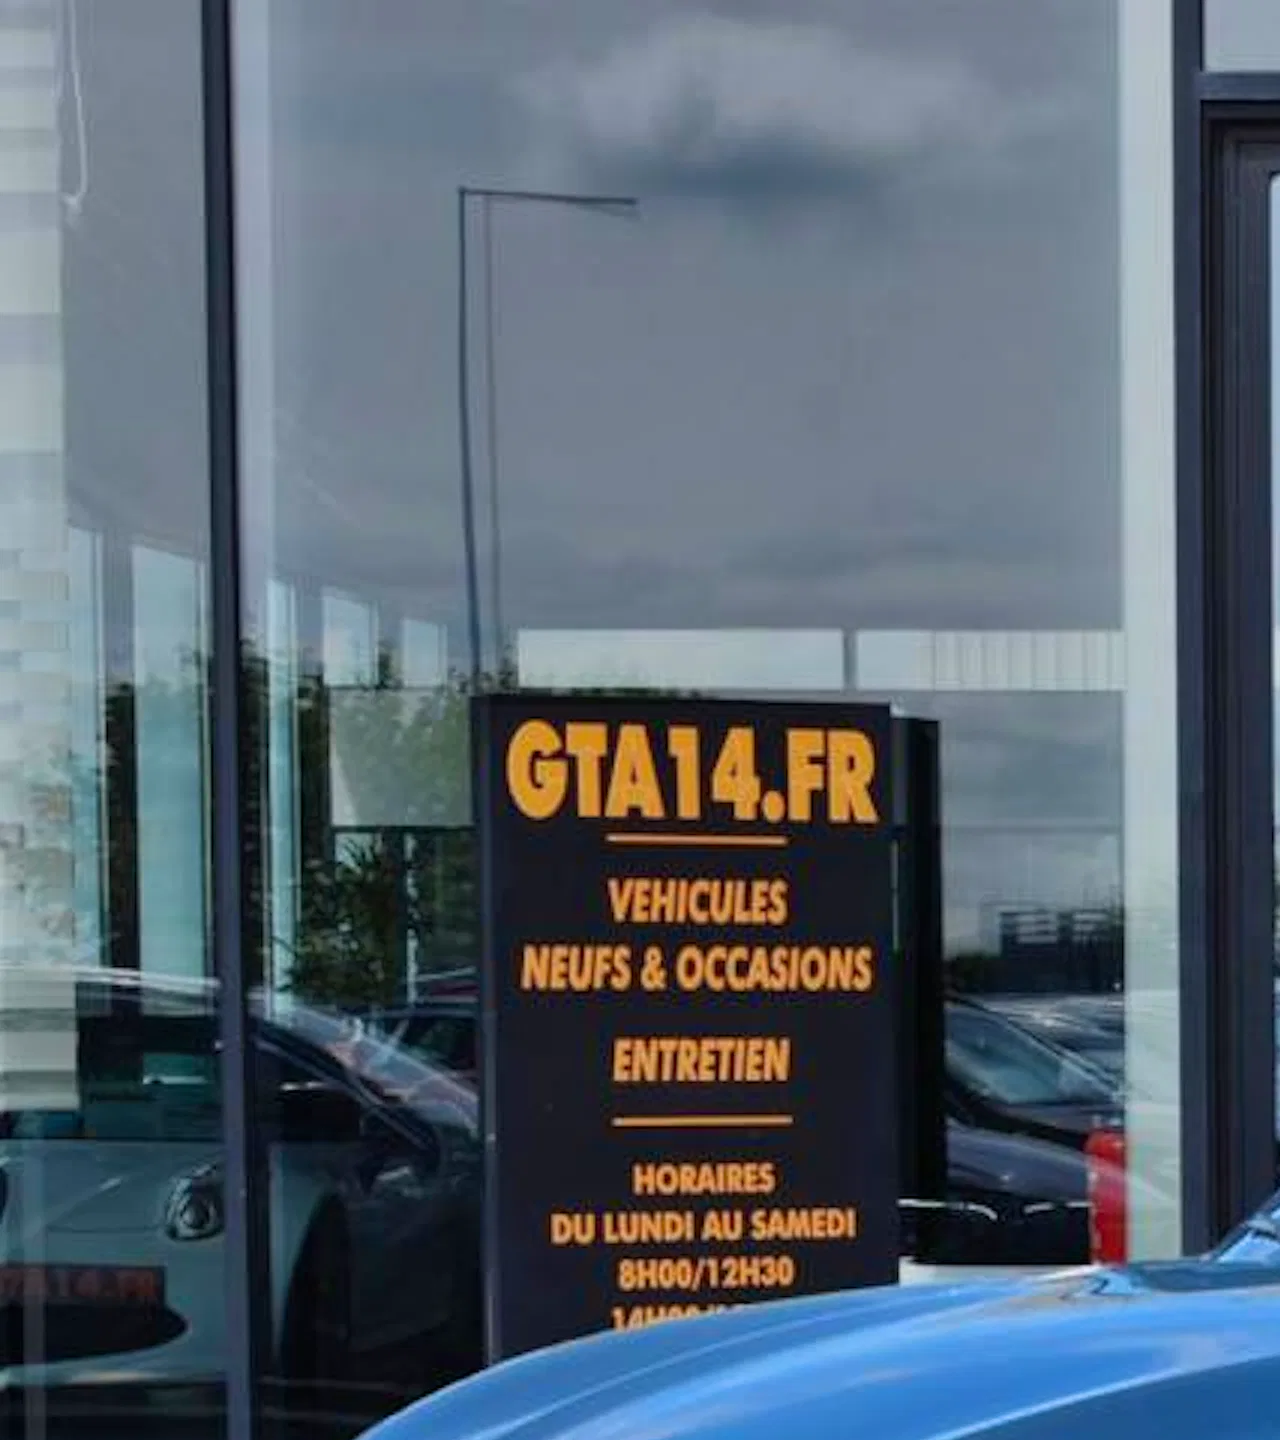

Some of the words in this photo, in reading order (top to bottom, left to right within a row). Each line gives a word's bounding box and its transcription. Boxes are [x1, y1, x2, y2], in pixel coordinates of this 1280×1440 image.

[506, 719, 879, 824] GTA14.FR
[608, 878, 788, 926] VEHICULES
[520, 945, 632, 992] NEUFS
[640, 946, 668, 992] &
[675, 945, 873, 992] OCCASIONS
[612, 1037, 791, 1083] ENTRETIEN
[632, 1162, 777, 1195] HORAIRES
[550, 1213, 596, 1245] DU
[603, 1211, 695, 1244] LUNDI
[701, 1210, 744, 1242] AU
[750, 1208, 857, 1241] SAMEDI
[618, 1256, 795, 1291] 8H00/12H30
